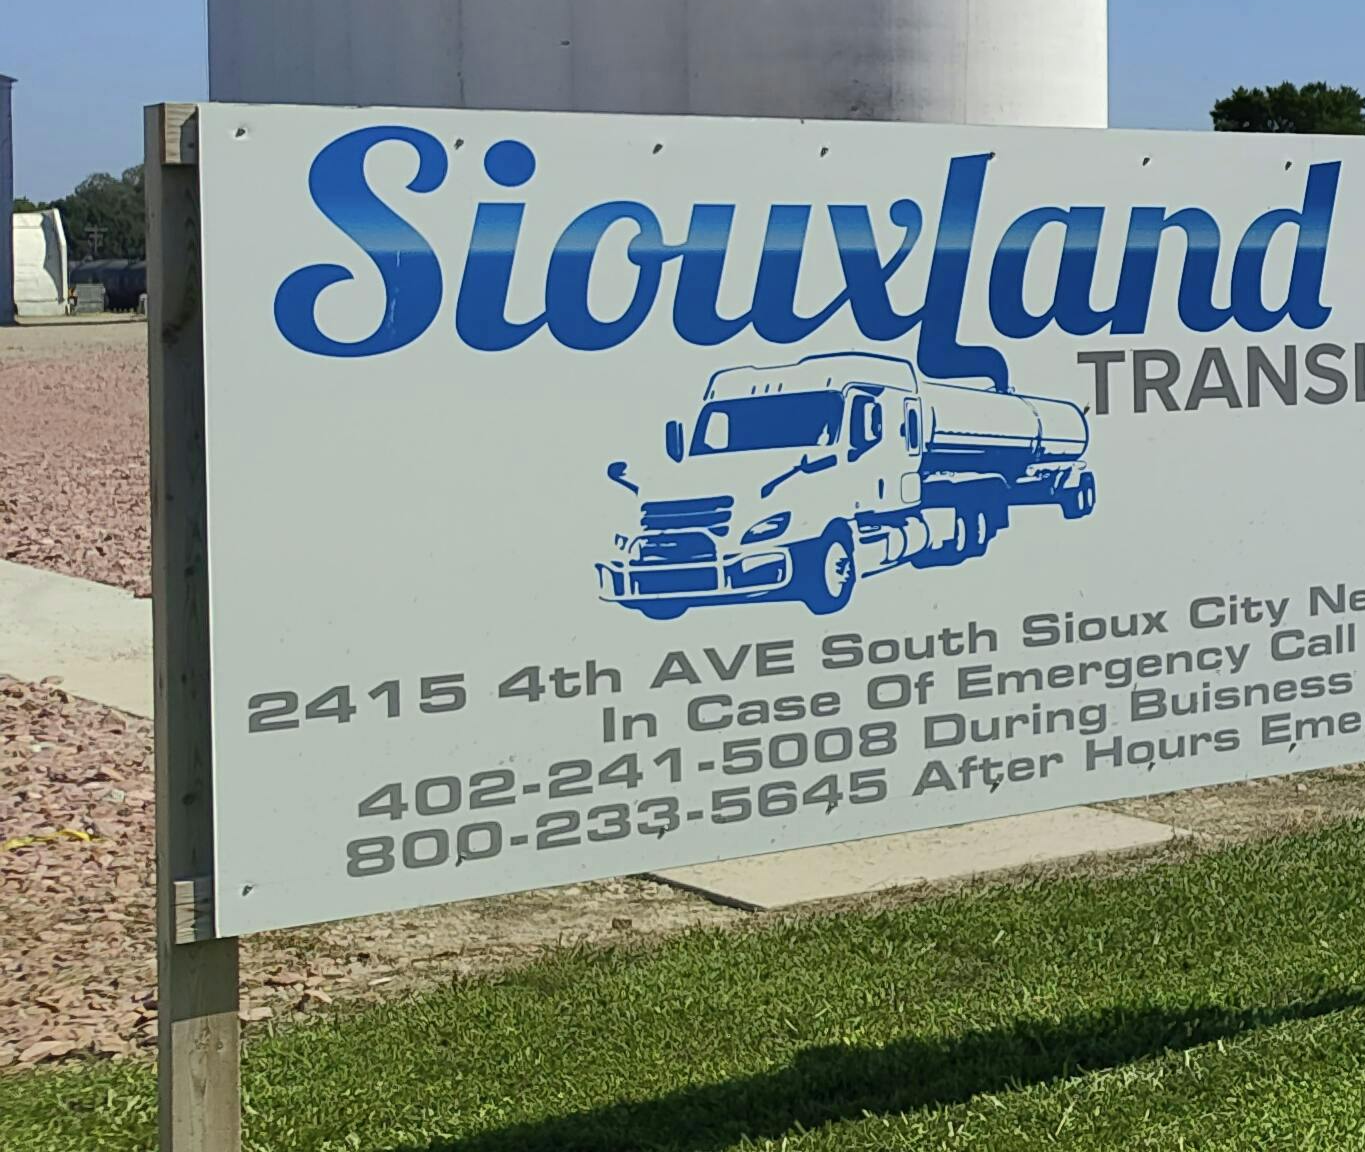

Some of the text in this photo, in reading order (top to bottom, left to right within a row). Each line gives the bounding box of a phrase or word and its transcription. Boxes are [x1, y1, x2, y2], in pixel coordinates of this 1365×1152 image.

[273, 125, 1342, 360] Siouxland
[248, 673, 467, 734] 2415
[498, 659, 622, 703] 4th
[649, 639, 795, 690] AVE
[821, 621, 999, 670] South
[1022, 610, 1169, 648] Sioux
[1189, 596, 1290, 630] City
[602, 622, 1356, 744] In Case Of Emergency Call
[346, 767, 888, 878] 800-233-5645
[912, 753, 1064, 797] After
[1085, 726, 1241, 772] Hours
[357, 720, 898, 821] 402-241-5008
[923, 702, 1108, 750] During
[1130, 672, 1353, 723] Buisness
